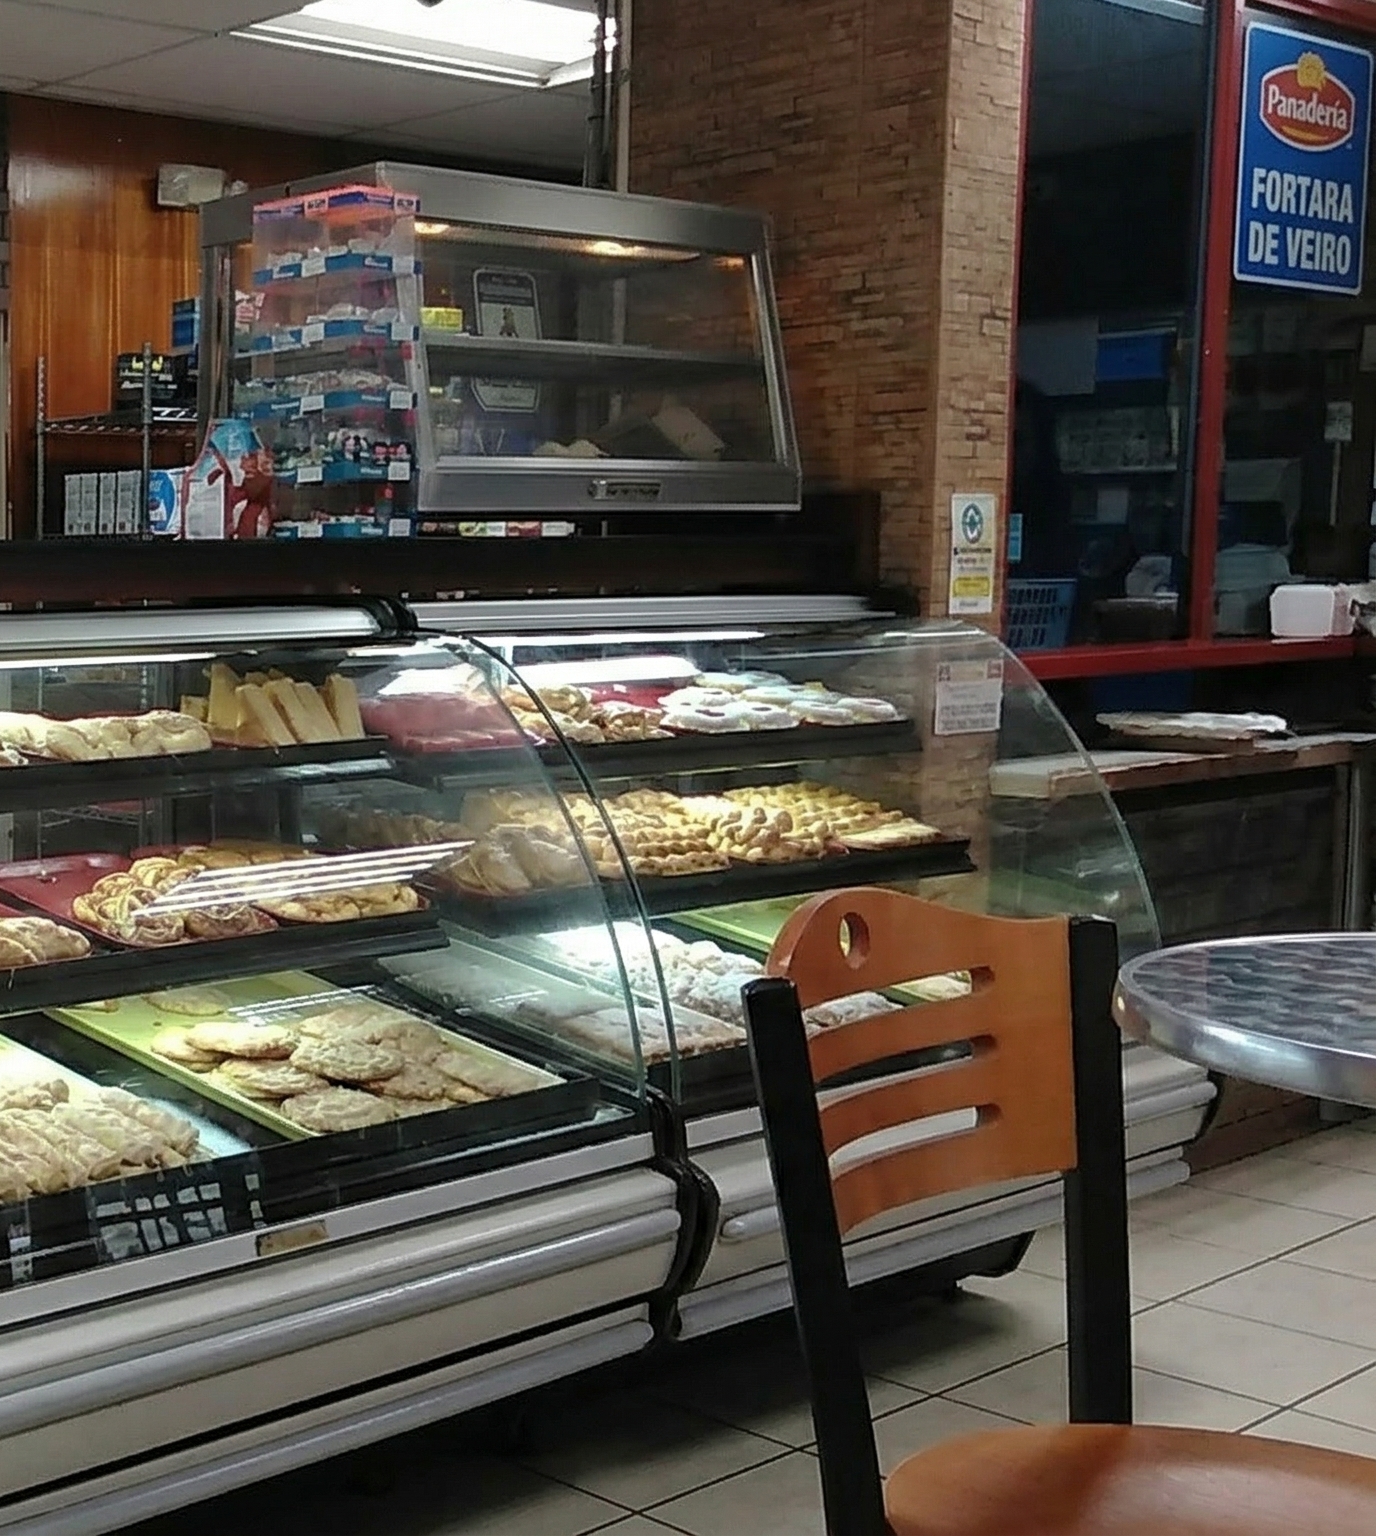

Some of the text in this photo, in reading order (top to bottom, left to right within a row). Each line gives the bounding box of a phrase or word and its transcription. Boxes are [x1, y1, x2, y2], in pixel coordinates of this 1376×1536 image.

[1267, 84, 1348, 130] Panadería
[1251, 167, 1353, 224] FORTARA
[1248, 221, 1351, 276] DE VEIRO
